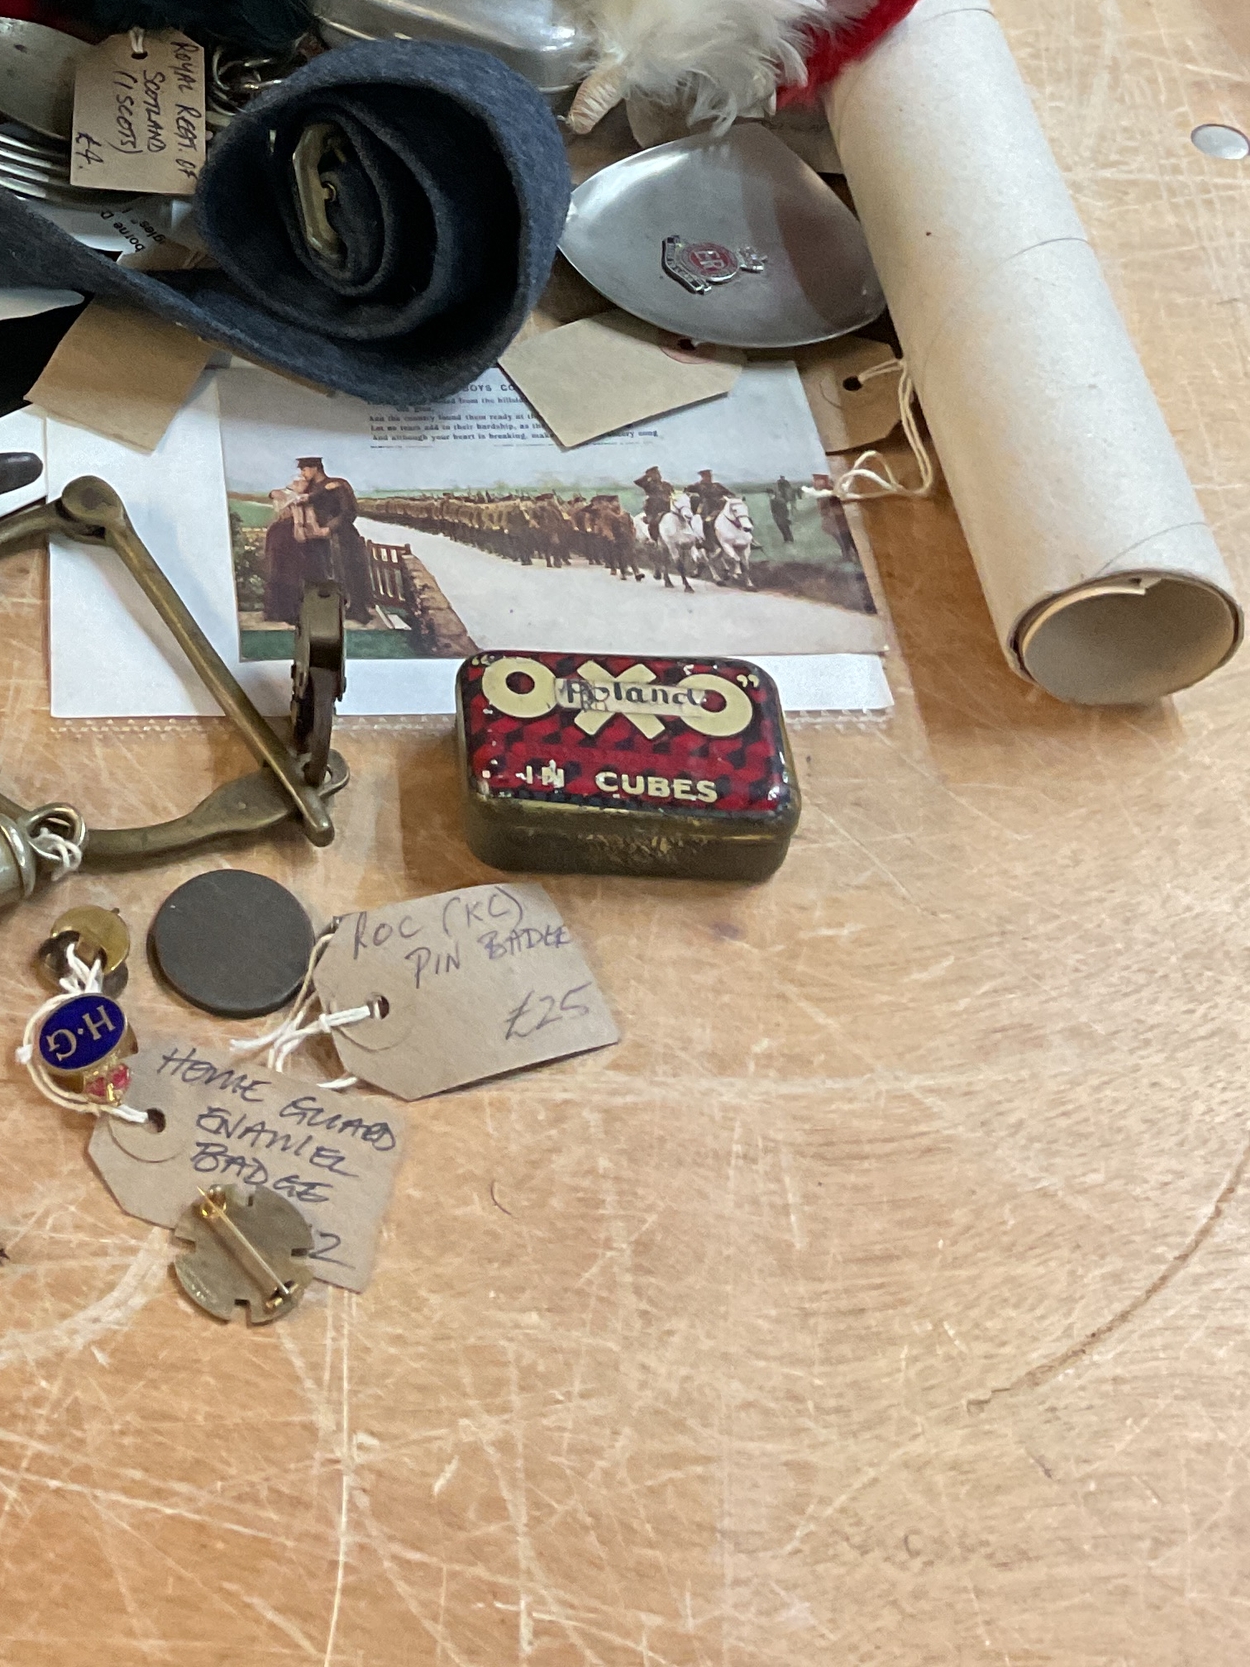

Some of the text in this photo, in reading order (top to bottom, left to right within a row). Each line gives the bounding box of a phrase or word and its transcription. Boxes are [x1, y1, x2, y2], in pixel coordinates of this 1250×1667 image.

[171, 41, 200, 93] ROYAL
[142, 69, 167, 153] SCOTLAND
[176, 157, 198, 180] OF
[594, 770, 719, 804] CUBES
[352, 885, 524, 960] ROC (KC)
[404, 942, 461, 989] PIN
[505, 981, 593, 1041] £25
[156, 1047, 272, 1102] HOME
[195, 1105, 359, 1178] ENAMEL
[190, 1141, 334, 1203] BADGE
